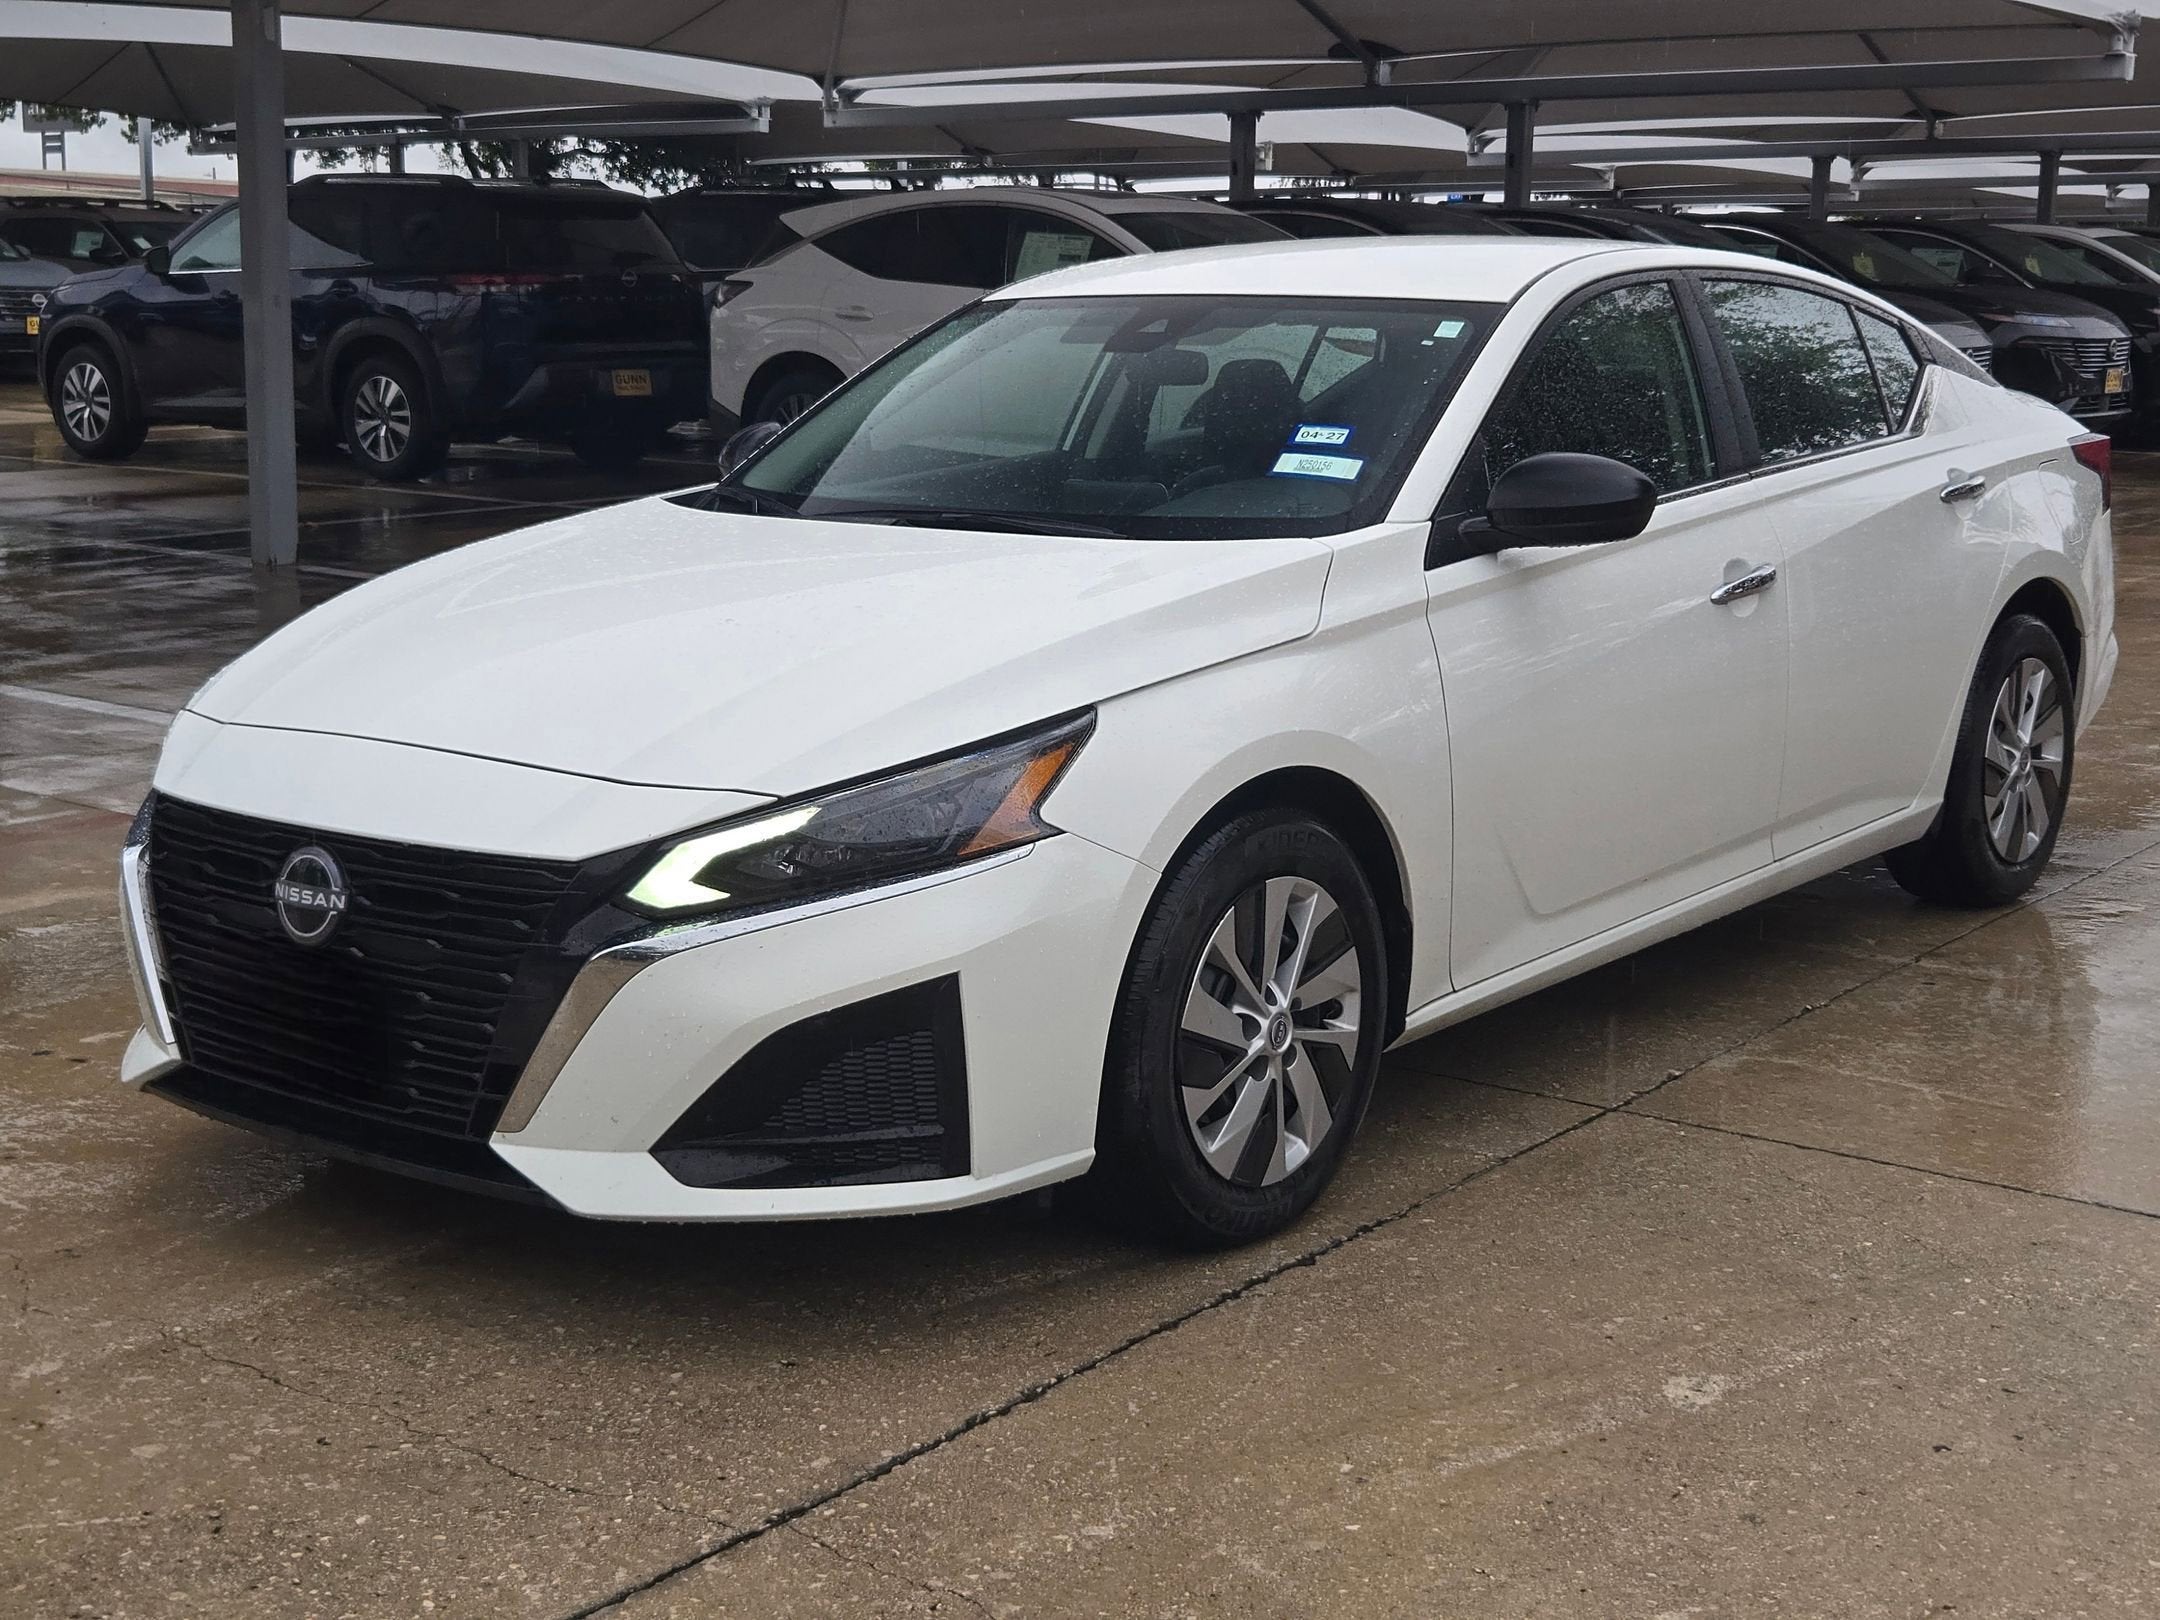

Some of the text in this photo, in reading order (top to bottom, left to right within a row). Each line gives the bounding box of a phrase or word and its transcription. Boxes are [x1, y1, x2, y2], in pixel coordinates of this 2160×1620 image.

[615, 374, 647, 384] GUNN
[1301, 430, 1346, 441] 04 27
[275, 882, 346, 909] NISSAN
